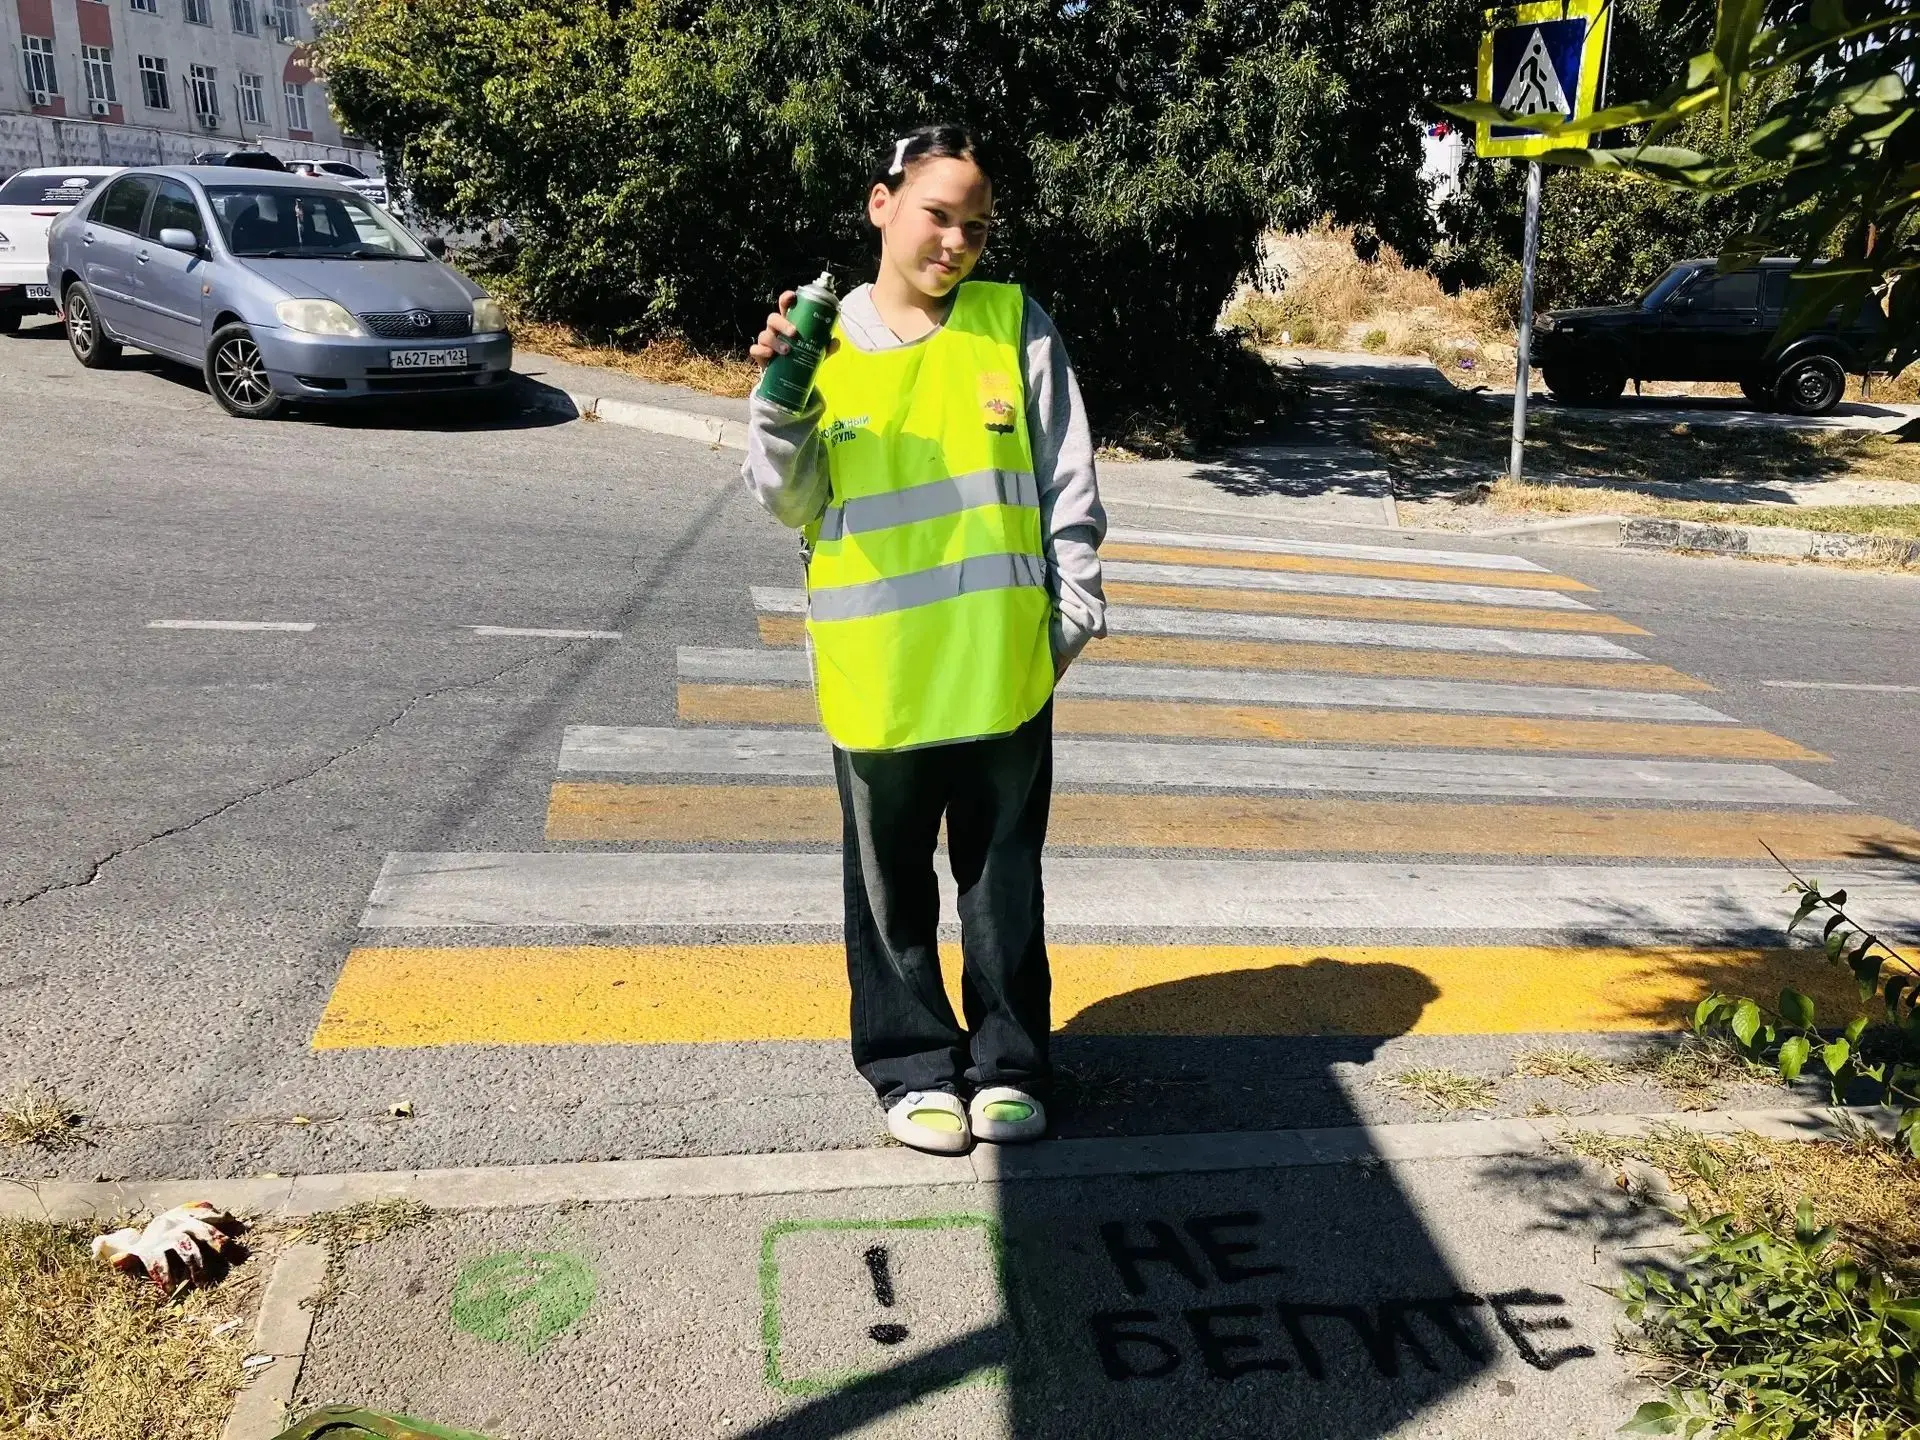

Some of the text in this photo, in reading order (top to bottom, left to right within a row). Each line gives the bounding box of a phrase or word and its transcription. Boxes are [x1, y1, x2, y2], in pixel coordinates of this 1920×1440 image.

[396, 350, 465, 367] А627ЕМ 123
[1099, 1210, 1284, 1295] НЕ
